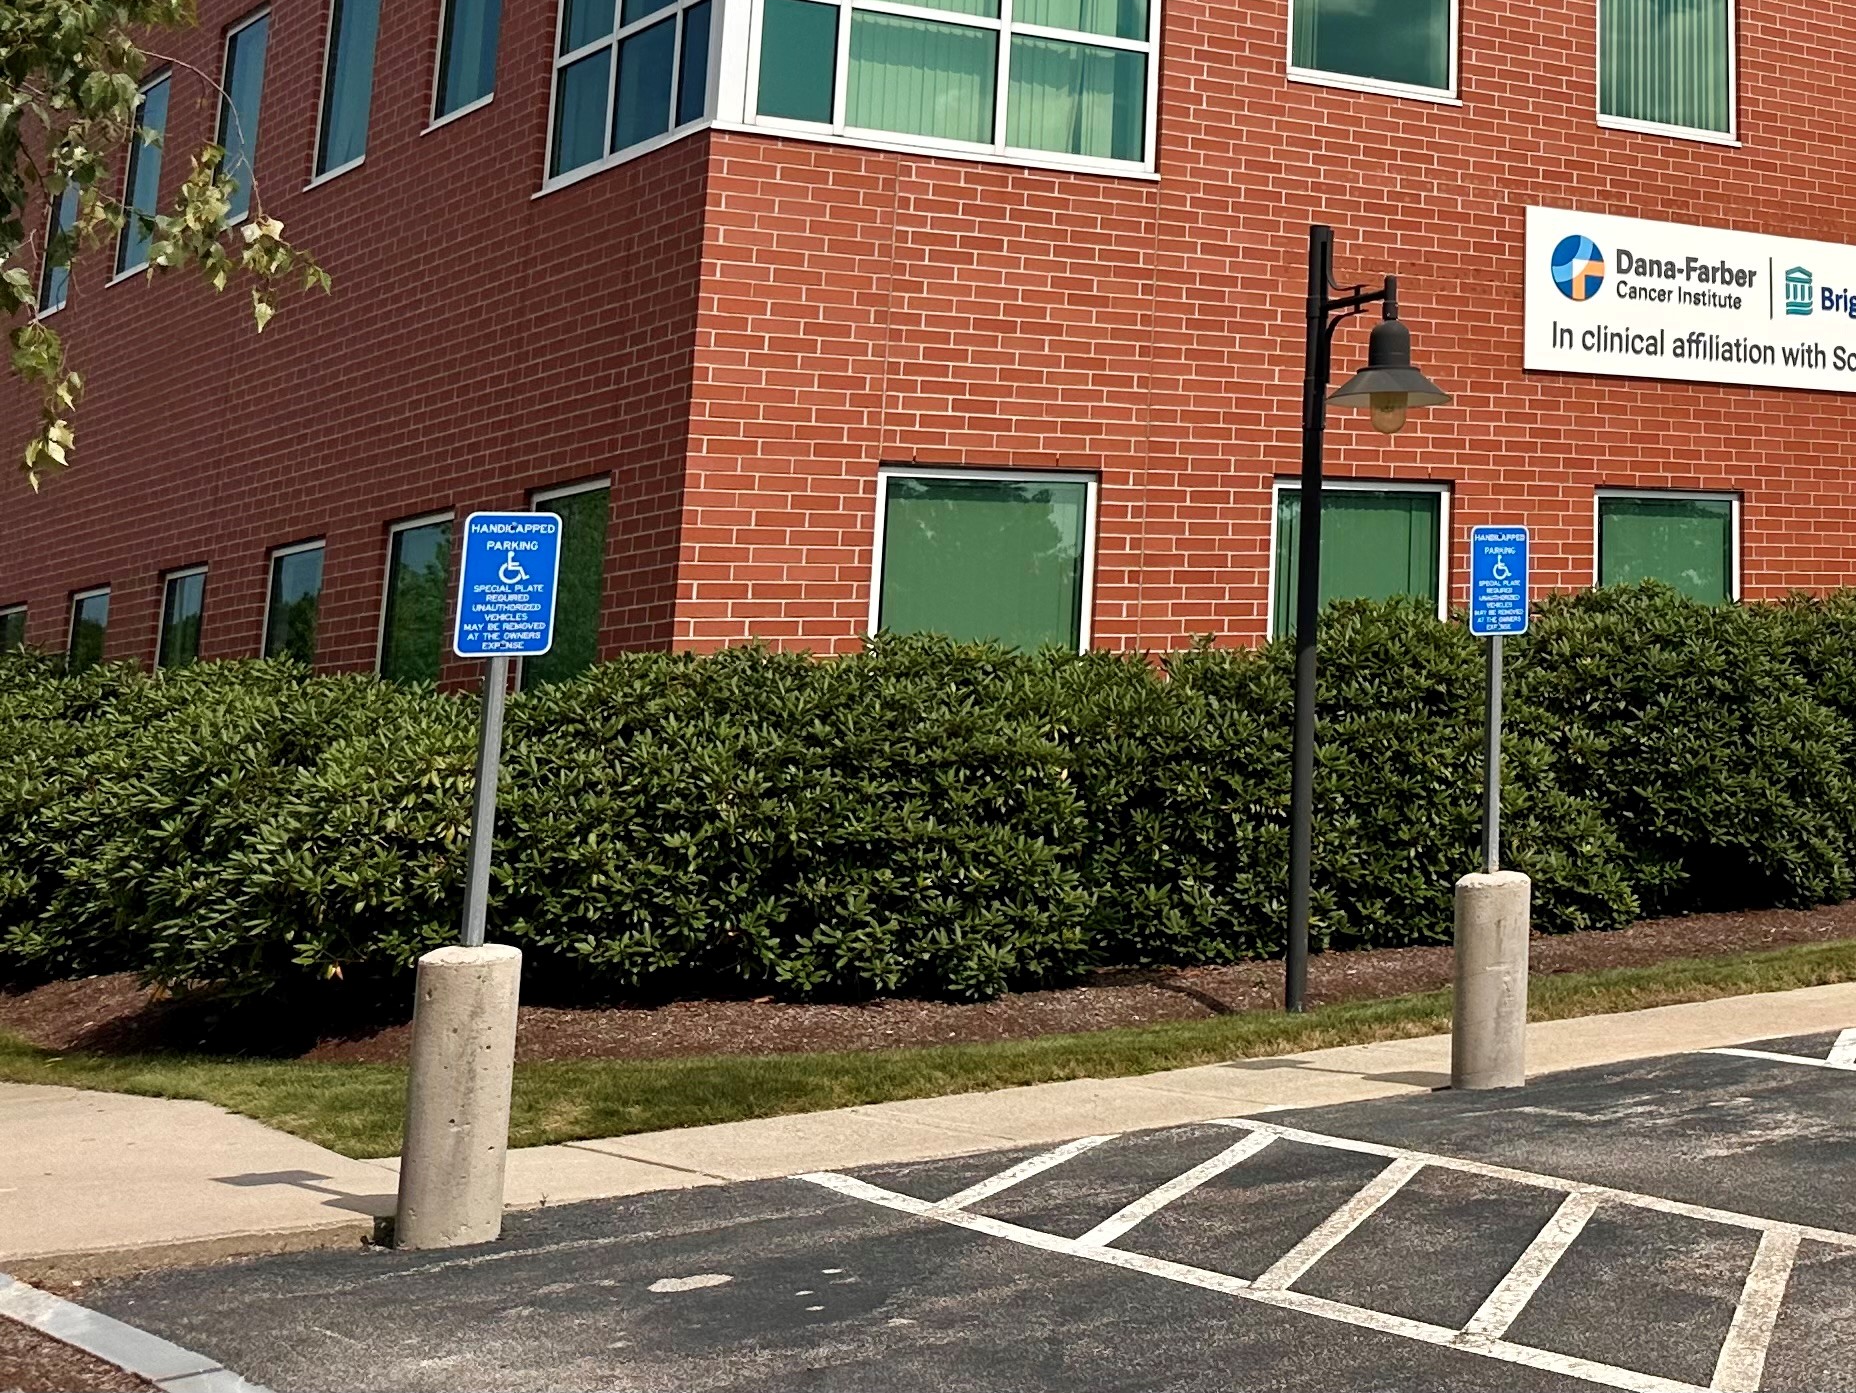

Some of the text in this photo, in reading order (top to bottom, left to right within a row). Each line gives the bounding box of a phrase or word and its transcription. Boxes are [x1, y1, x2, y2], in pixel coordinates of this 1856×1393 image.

[1616, 248, 1757, 288] Dana-Farber
[1616, 280, 1742, 310] Cancer Institute
[1552, 321, 1573, 349] In
[1581, 324, 1665, 356] clinical
[1672, 331, 1775, 365] affiliation
[1781, 342, 1826, 369] with
[471, 523, 555, 534] HANDICAPPED
[486, 541, 538, 551] PARKING
[473, 584, 544, 593] SPECIAL PLATE
[485, 594, 529, 602] REQUIRED
[484, 613, 528, 621] VEHICLES
[463, 622, 546, 631] MAY BE REMOVED
[466, 632, 480, 641] AT
[483, 632, 500, 640] THE
